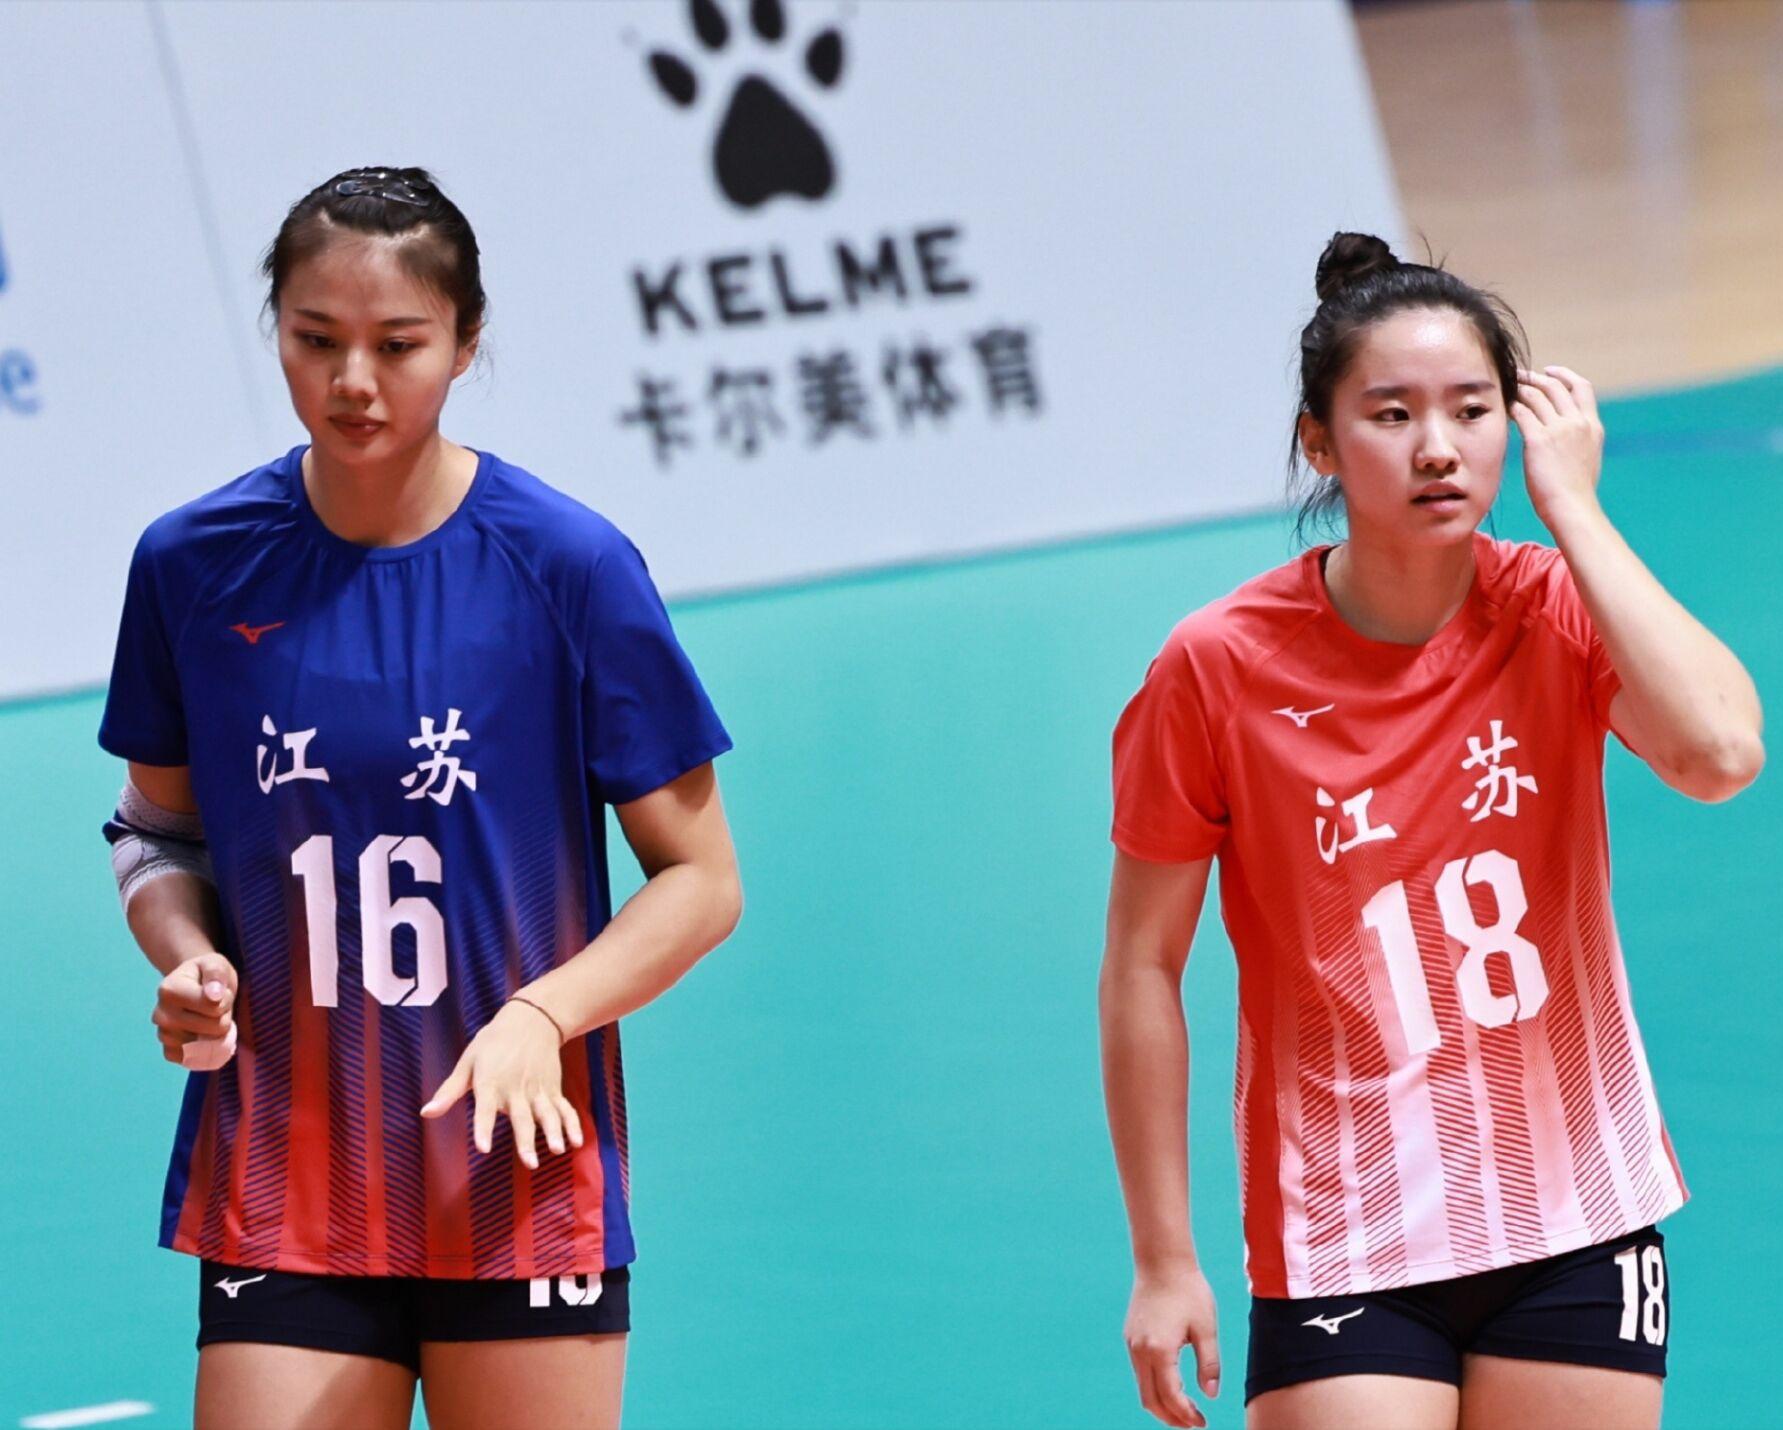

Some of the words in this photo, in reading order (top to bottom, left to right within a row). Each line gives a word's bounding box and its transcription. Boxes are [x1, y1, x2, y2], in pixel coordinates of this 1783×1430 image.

[630, 225, 974, 337] KELME
[617, 325, 1044, 464] 卡尔美体育
[291, 834, 448, 1008] 16
[1361, 850, 1550, 1055] 18
[1614, 1245, 1666, 1346] 18
